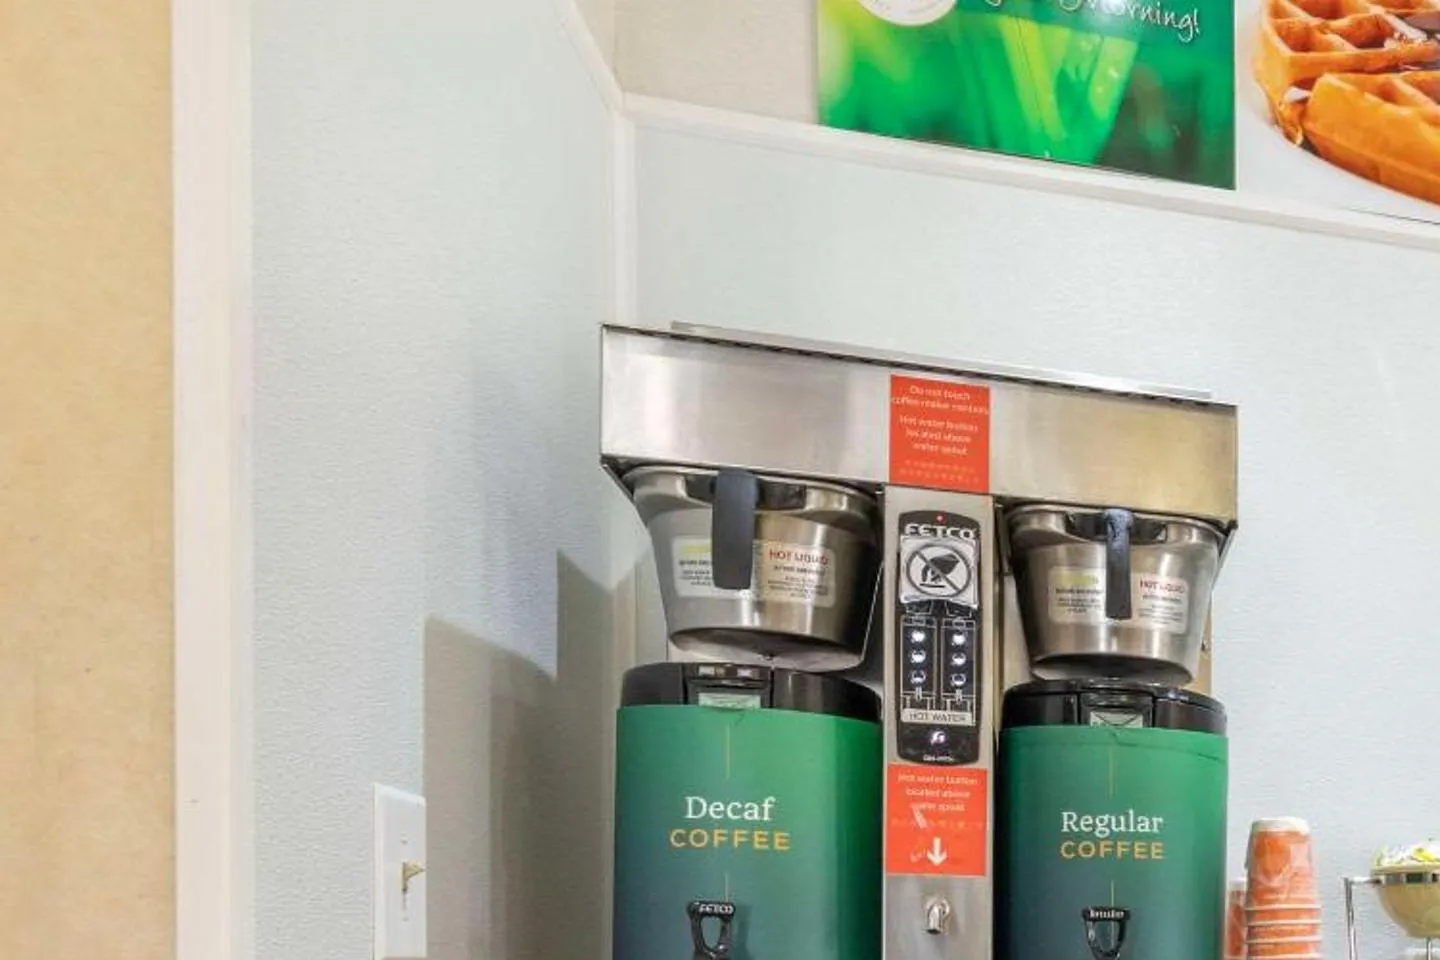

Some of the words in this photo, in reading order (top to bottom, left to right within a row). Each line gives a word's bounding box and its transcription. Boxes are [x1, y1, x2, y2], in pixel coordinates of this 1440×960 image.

[1083, 0, 1200, 42] orning!
[769, 549, 791, 562] HOT
[909, 711, 929, 721] HOT
[685, 796, 776, 821] Decaf
[1061, 809, 1164, 837] Regular
[670, 829, 790, 850] COFFEE
[1060, 841, 1165, 860] COFFEE
